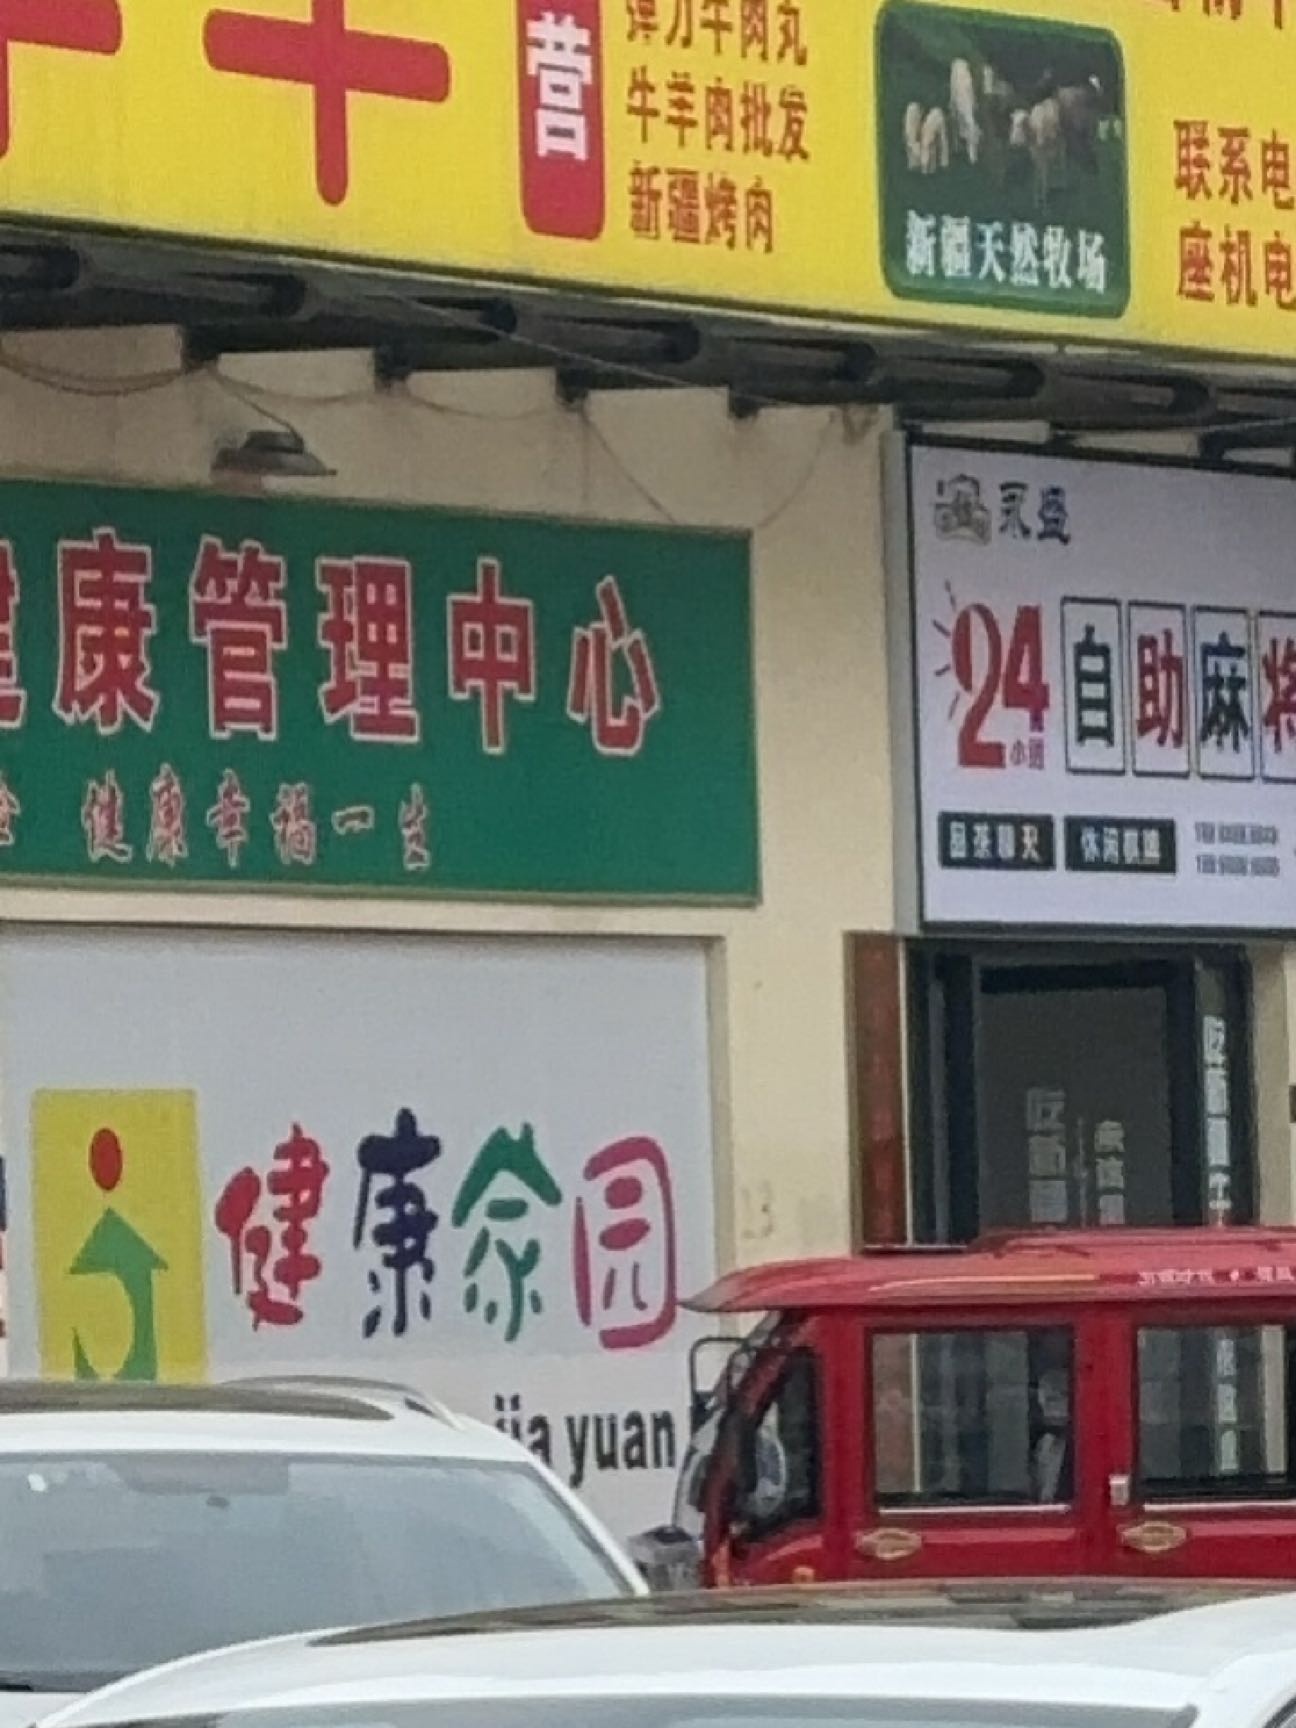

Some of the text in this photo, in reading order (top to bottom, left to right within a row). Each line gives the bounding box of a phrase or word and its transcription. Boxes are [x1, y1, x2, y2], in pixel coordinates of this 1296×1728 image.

[626, 64, 810, 162] 牛羊肉批发
[628, 159, 774, 254] 新疆烤肉
[906, 209, 1107, 294] 新疆天然牧场
[0, 525, 661, 757] 康管理中心
[81, 762, 431, 872] 健康幸福一生
[214, 1106, 678, 1350] 健康家园
[564, 1410, 677, 1489] yuan
